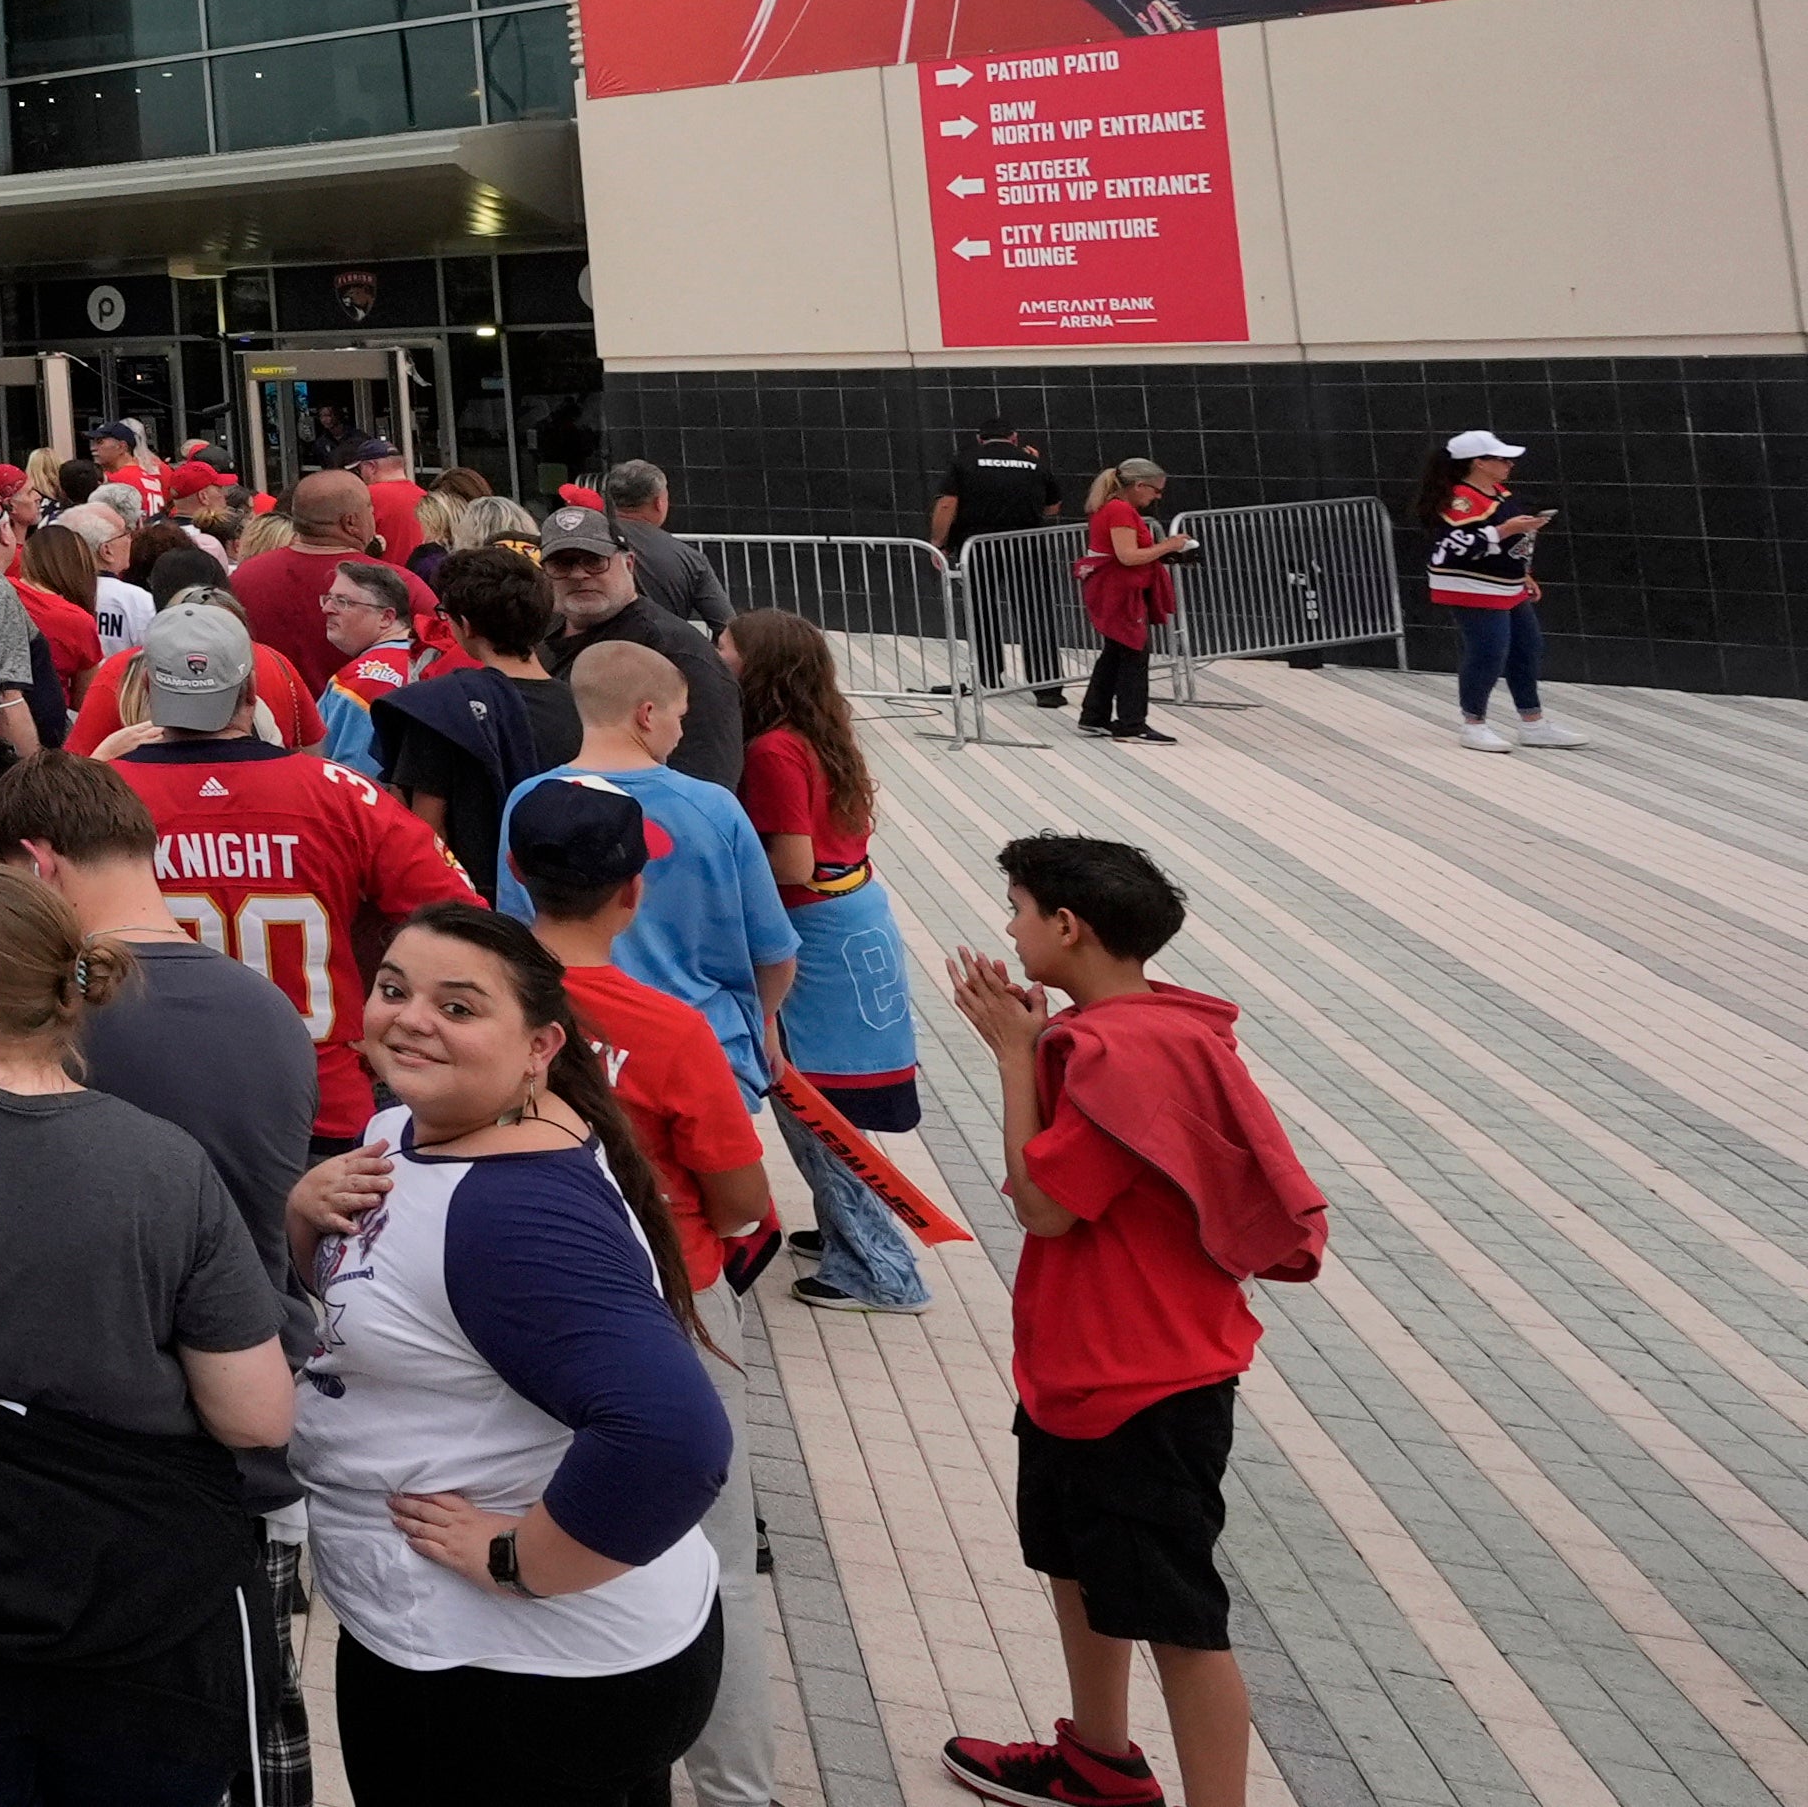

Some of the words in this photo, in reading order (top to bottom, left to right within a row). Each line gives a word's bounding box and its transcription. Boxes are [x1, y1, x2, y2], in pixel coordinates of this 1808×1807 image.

[986, 60, 1057, 83] PATRON
[1064, 50, 1119, 76] PATIO
[989, 101, 1036, 122] BMW
[991, 121, 1055, 145] NORTH
[1061, 118, 1093, 140] VIP
[1100, 110, 1205, 138] ENTRANCE
[995, 158, 1090, 182] SEATGEEK
[997, 183, 1059, 207] SOUTH
[1067, 180, 1097, 202] VIP
[1104, 173, 1211, 200] ENTRANCE
[1001, 224, 1042, 246] CITY
[1050, 218, 1159, 244] FURNITURE
[1003, 247, 1077, 268] LOUNGE
[1019, 298, 1106, 313] AMERANT
[1109, 297, 1155, 311] BANK
[1060, 314, 1113, 329] ARENA
[977, 459, 1038, 471] SECURITY
[156, 673, 215, 688] CHAMPIONS
[154, 832, 299, 880] KNIGHT
[841, 927, 908, 1031] 9
